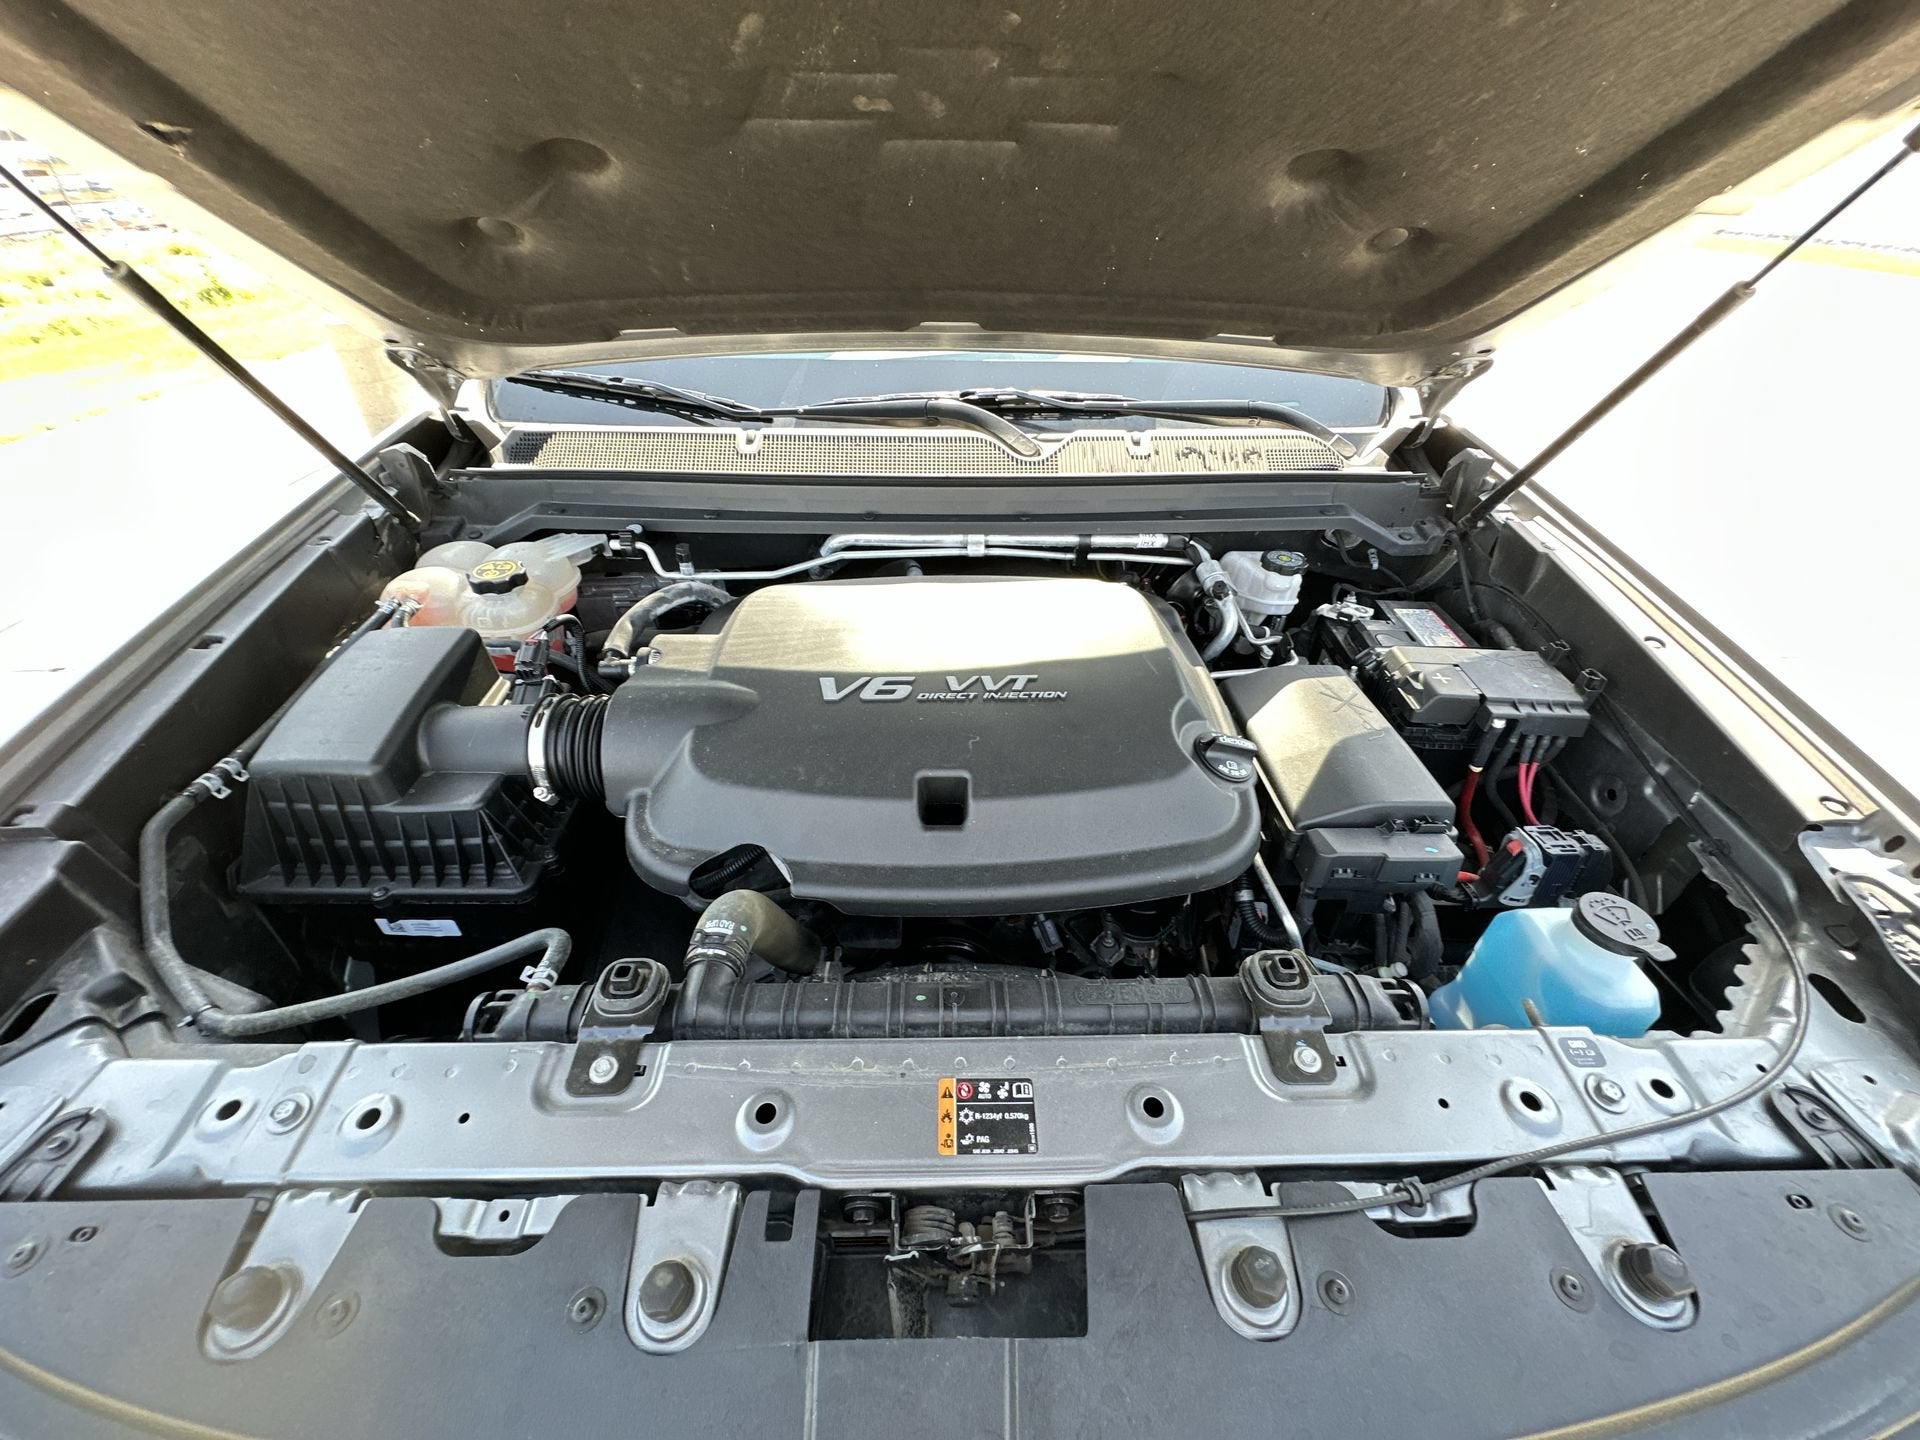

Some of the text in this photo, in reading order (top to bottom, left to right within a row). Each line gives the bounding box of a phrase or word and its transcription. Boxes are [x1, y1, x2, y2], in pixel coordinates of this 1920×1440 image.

[819, 676, 916, 701] V6
[945, 674, 1039, 691] VVT
[916, 690, 1068, 700] DIRECT INJECTION
[976, 1135, 990, 1143] PAG
